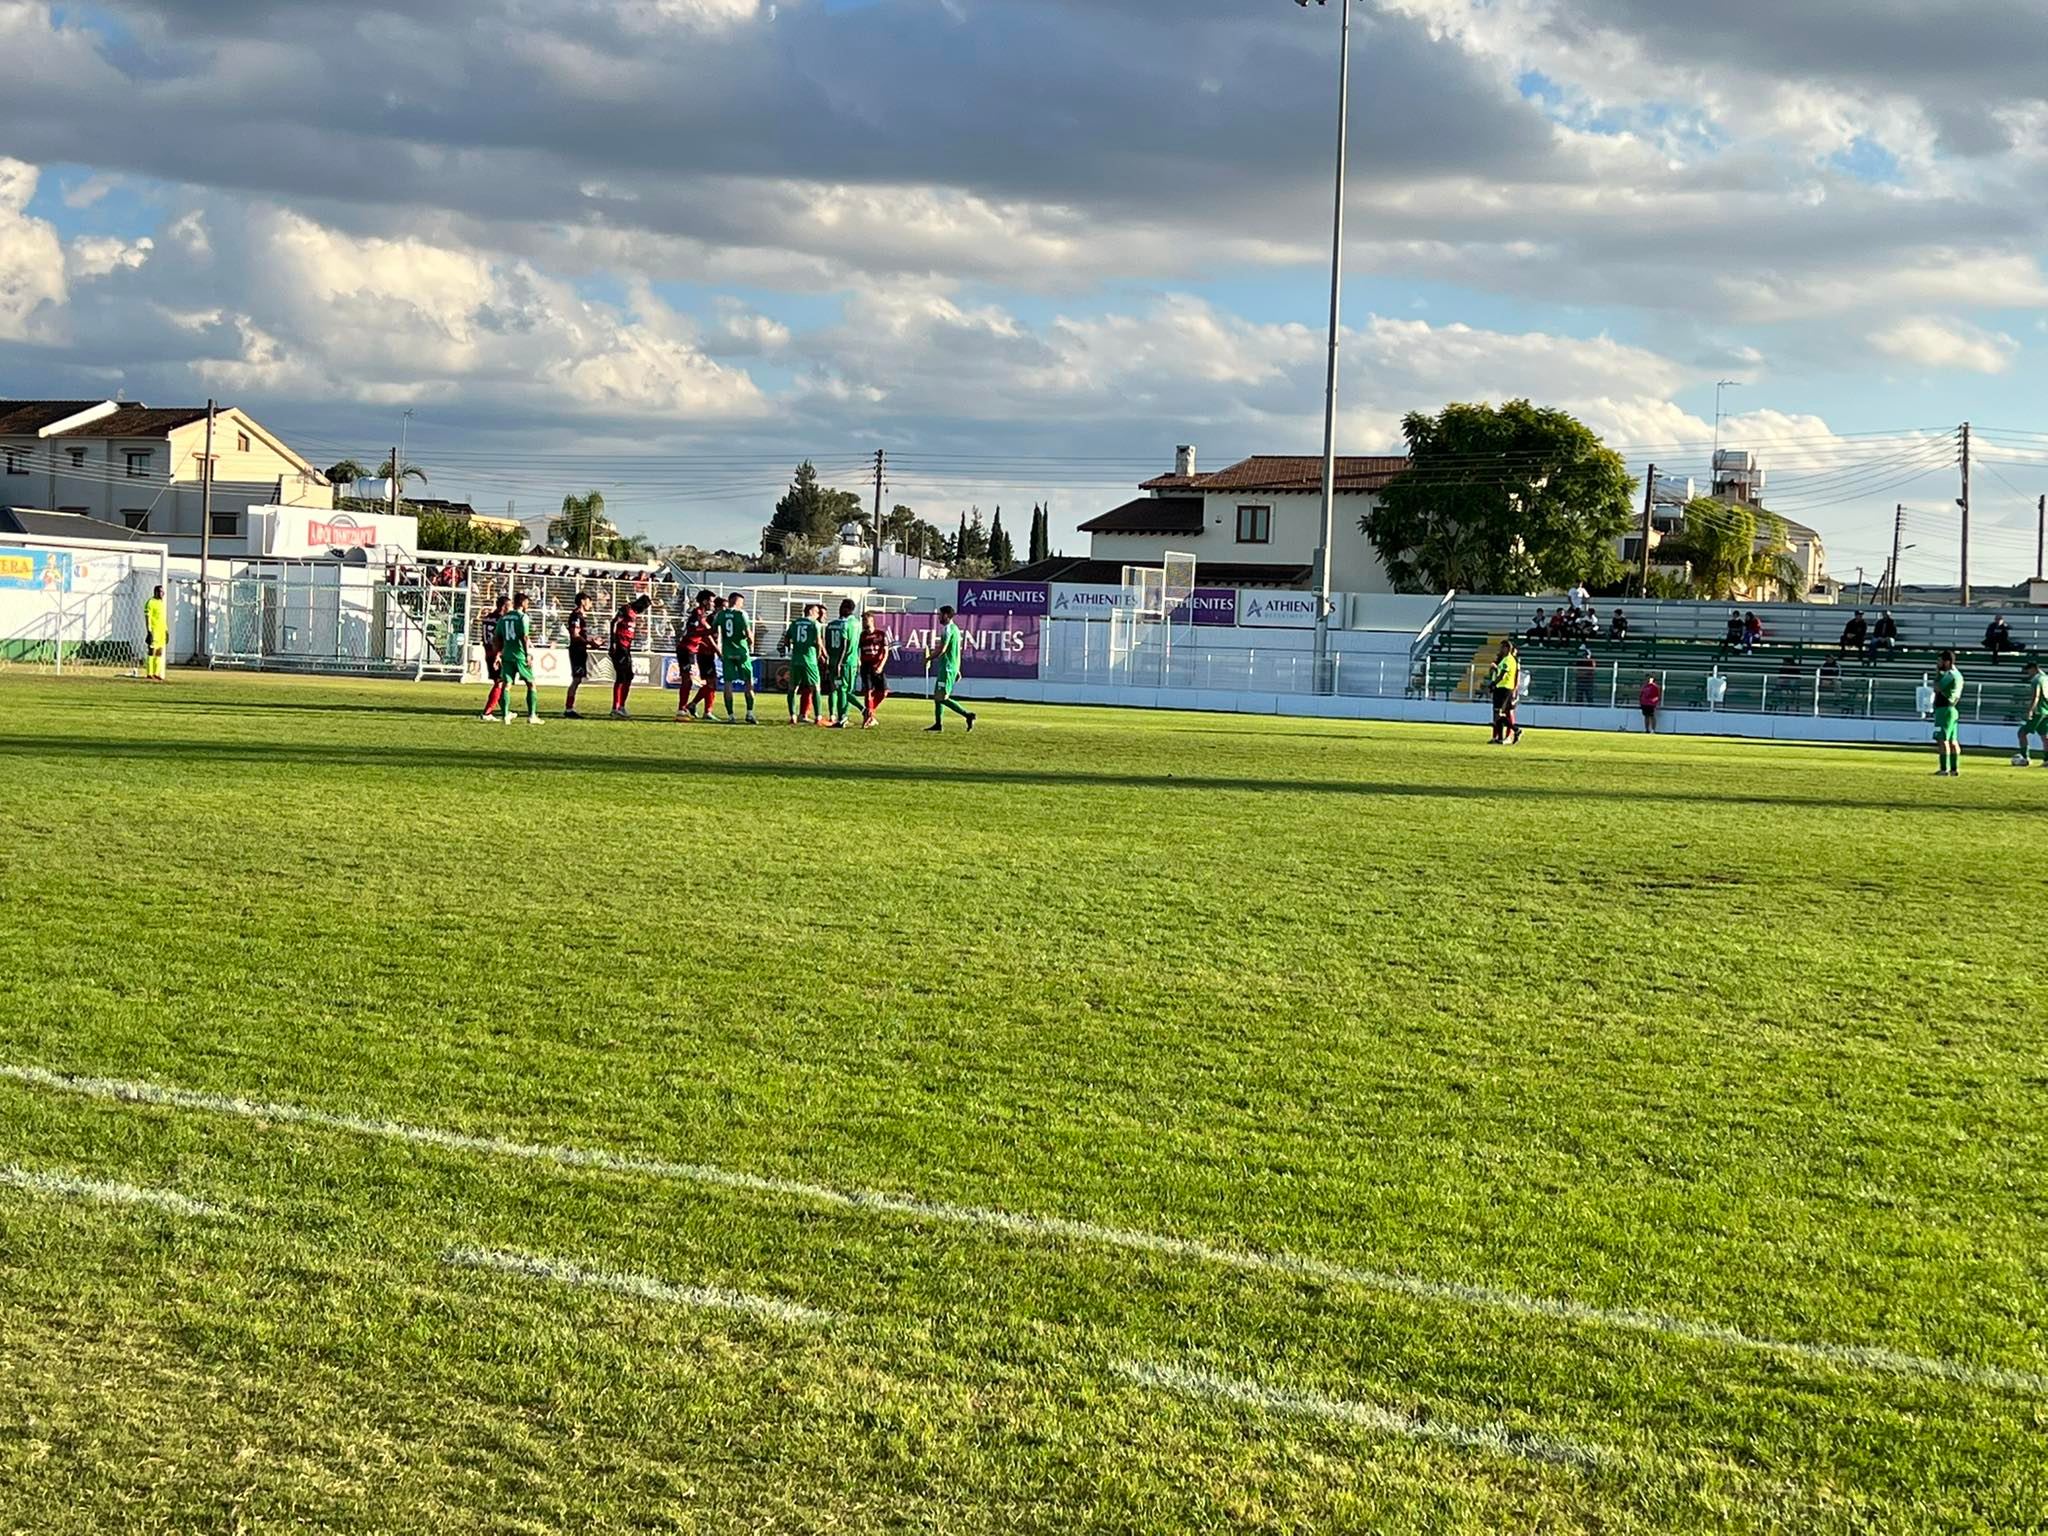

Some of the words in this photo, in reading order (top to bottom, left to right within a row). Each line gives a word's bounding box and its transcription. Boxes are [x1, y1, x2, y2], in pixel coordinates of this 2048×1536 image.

[0, 559, 30, 574] ERA
[979, 589, 1046, 603] ATHIENITES
[1264, 600, 1336, 614] ATHIENIS
[504, 620, 517, 641] 14
[725, 618, 734, 638] 9
[796, 624, 808, 643] 15
[905, 628, 1025, 653] ATHENITES
